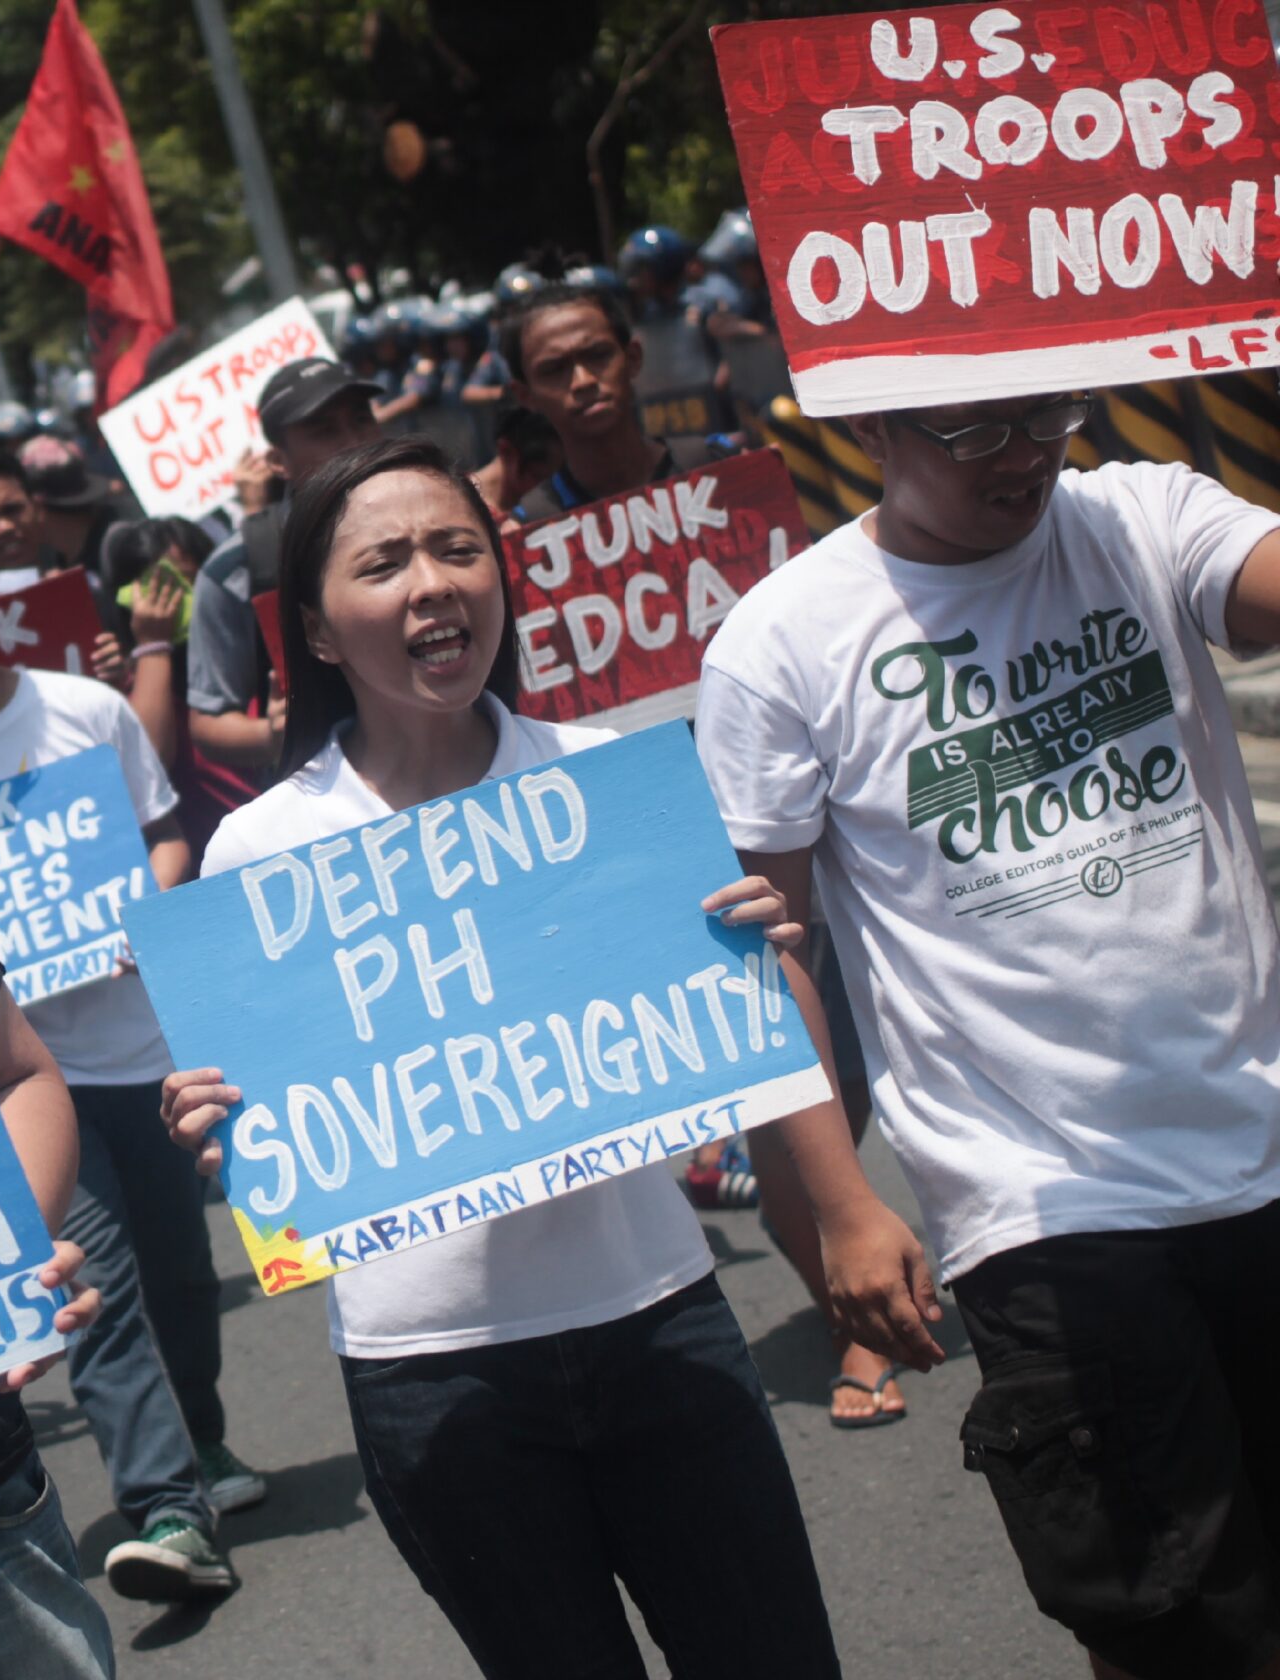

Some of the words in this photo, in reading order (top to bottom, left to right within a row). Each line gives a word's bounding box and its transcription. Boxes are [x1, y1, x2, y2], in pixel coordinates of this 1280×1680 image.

[870, 7, 1056, 81] U.S.
[821, 71, 1243, 186] TROOPS
[787, 207, 991, 326] OUT
[1029, 172, 1280, 299] NOW
[148, 417, 224, 492] OUT
[524, 475, 728, 590] JUNK
[871, 628, 996, 732] To
[1006, 607, 1147, 702] write
[929, 739, 968, 773] IS
[989, 668, 1137, 757] ALREADY
[937, 744, 1187, 865] choose
[1044, 727, 1096, 765] TO
[240, 766, 588, 961] DEFEND
[945, 872, 1004, 900] COLLEGE
[1006, 853, 1064, 880] EDITORS
[1066, 836, 1108, 861] GUILD
[1109, 829, 1127, 845] OF
[1131, 821, 1148, 838] THE
[333, 908, 494, 1043] PH
[232, 940, 786, 1216] SOVEREIGNTY!
[323, 1175, 527, 1271] KABATAAN
[540, 1099, 748, 1200] PARTYLIST
